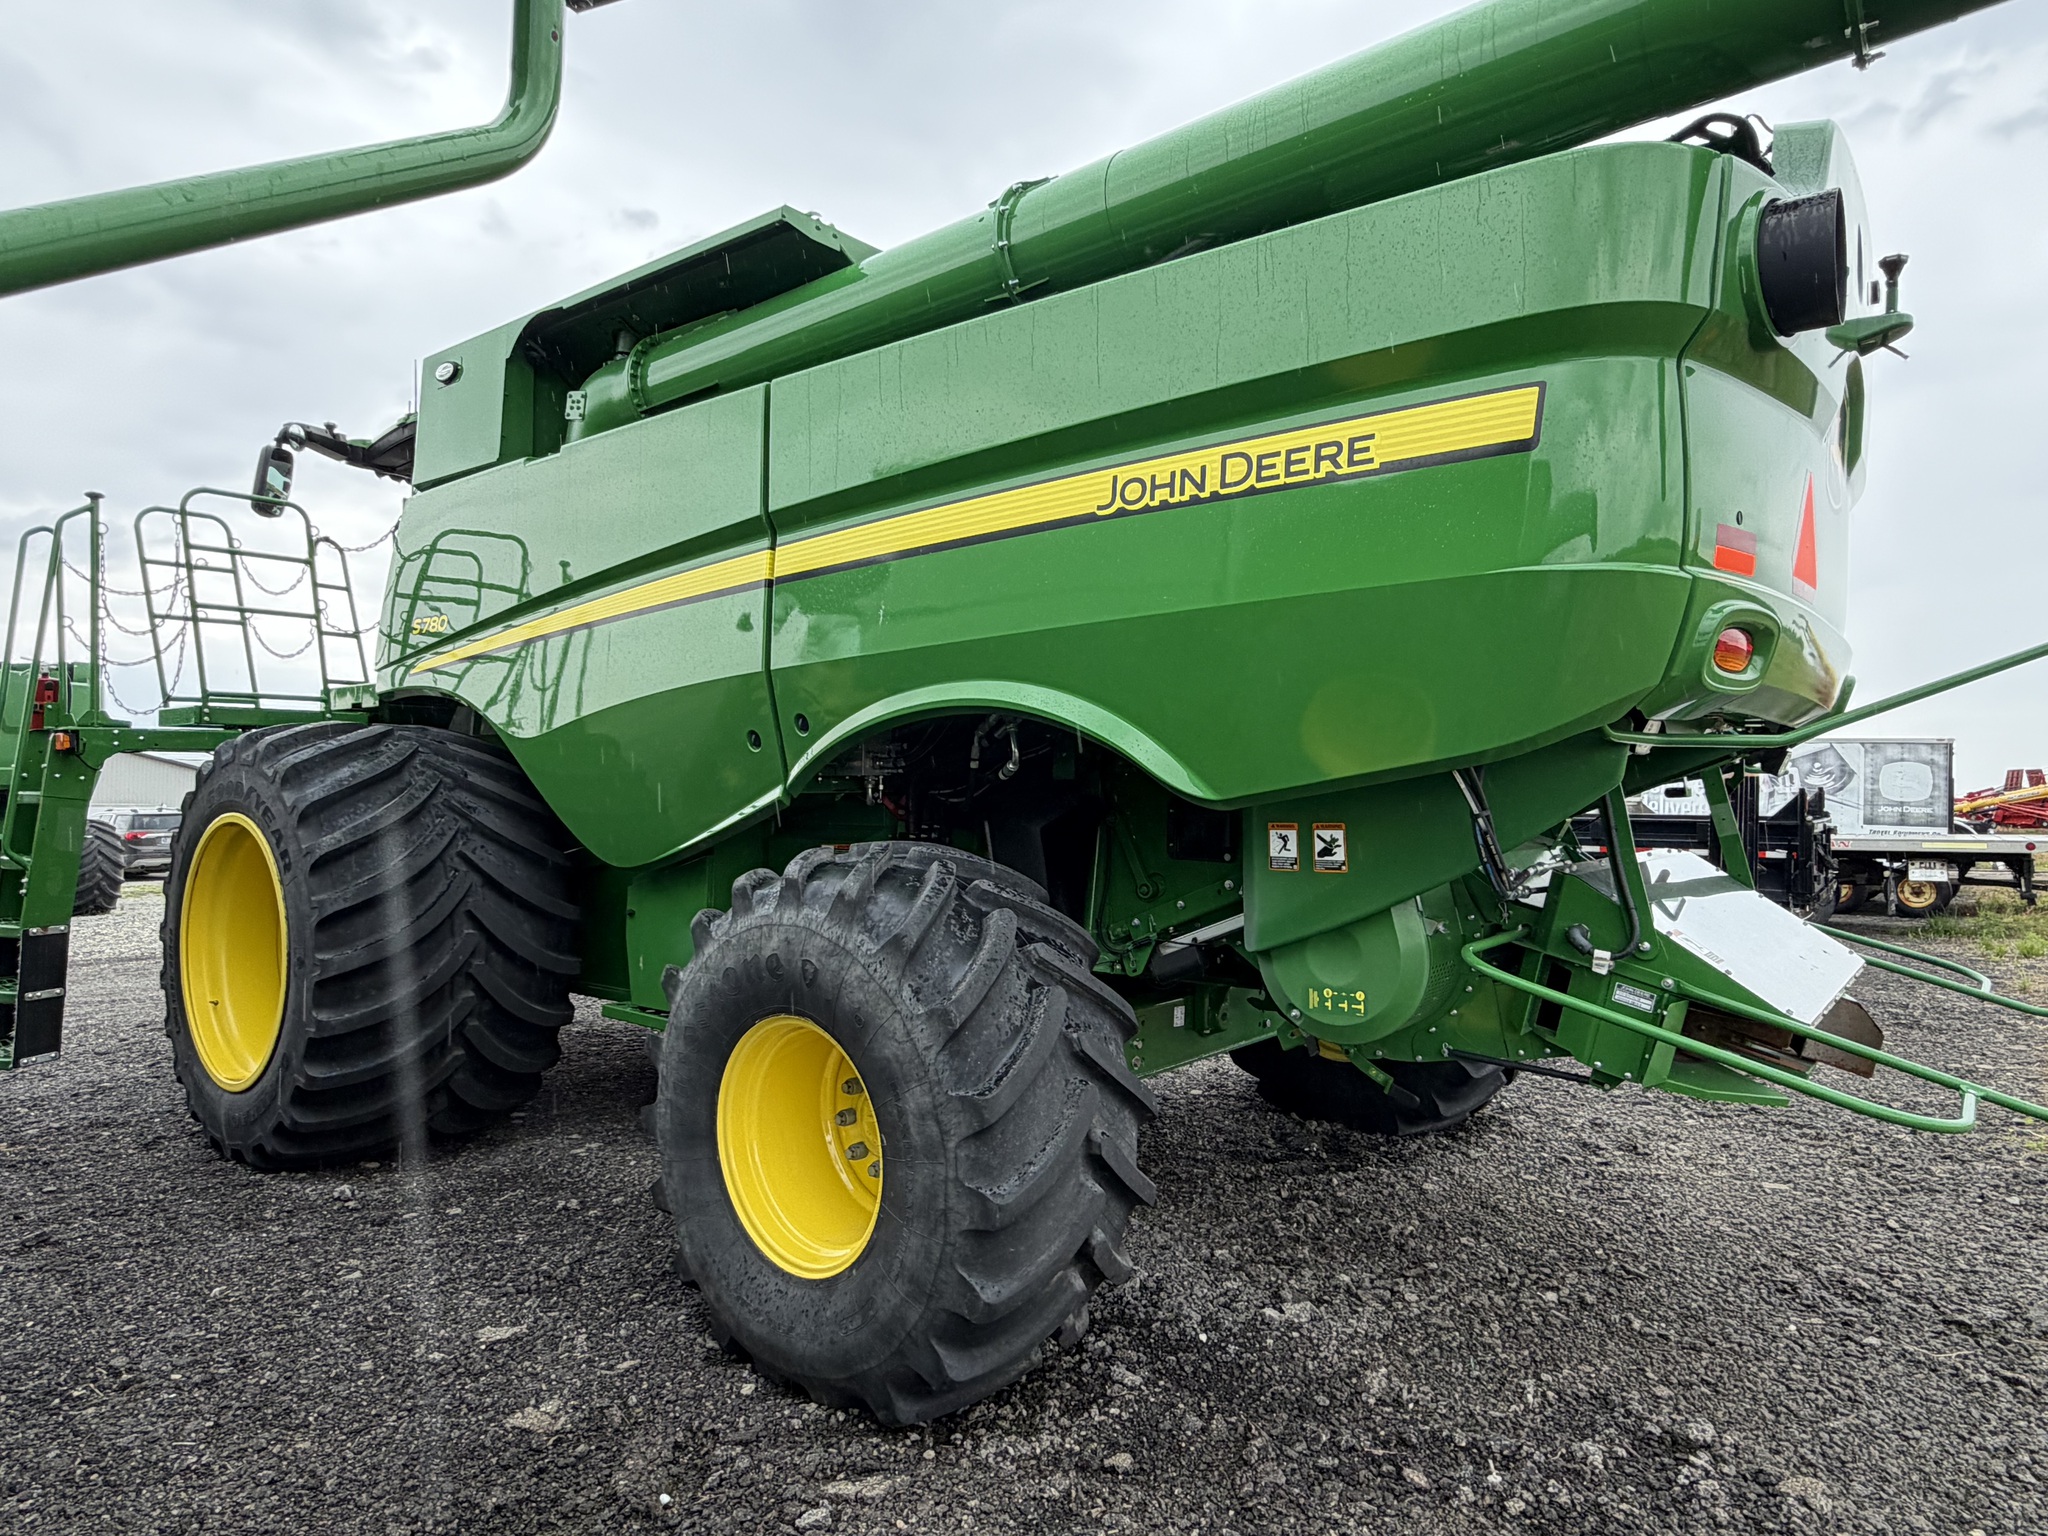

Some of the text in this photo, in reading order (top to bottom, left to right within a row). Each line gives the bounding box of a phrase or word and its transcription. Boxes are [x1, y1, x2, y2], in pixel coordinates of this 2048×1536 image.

[1096, 433, 1376, 512] JOHN DEERE
[411, 614, 449, 635] S780
[206, 779, 293, 876] GOODYEAR
[1878, 805, 1934, 814] JOHN DEERE
